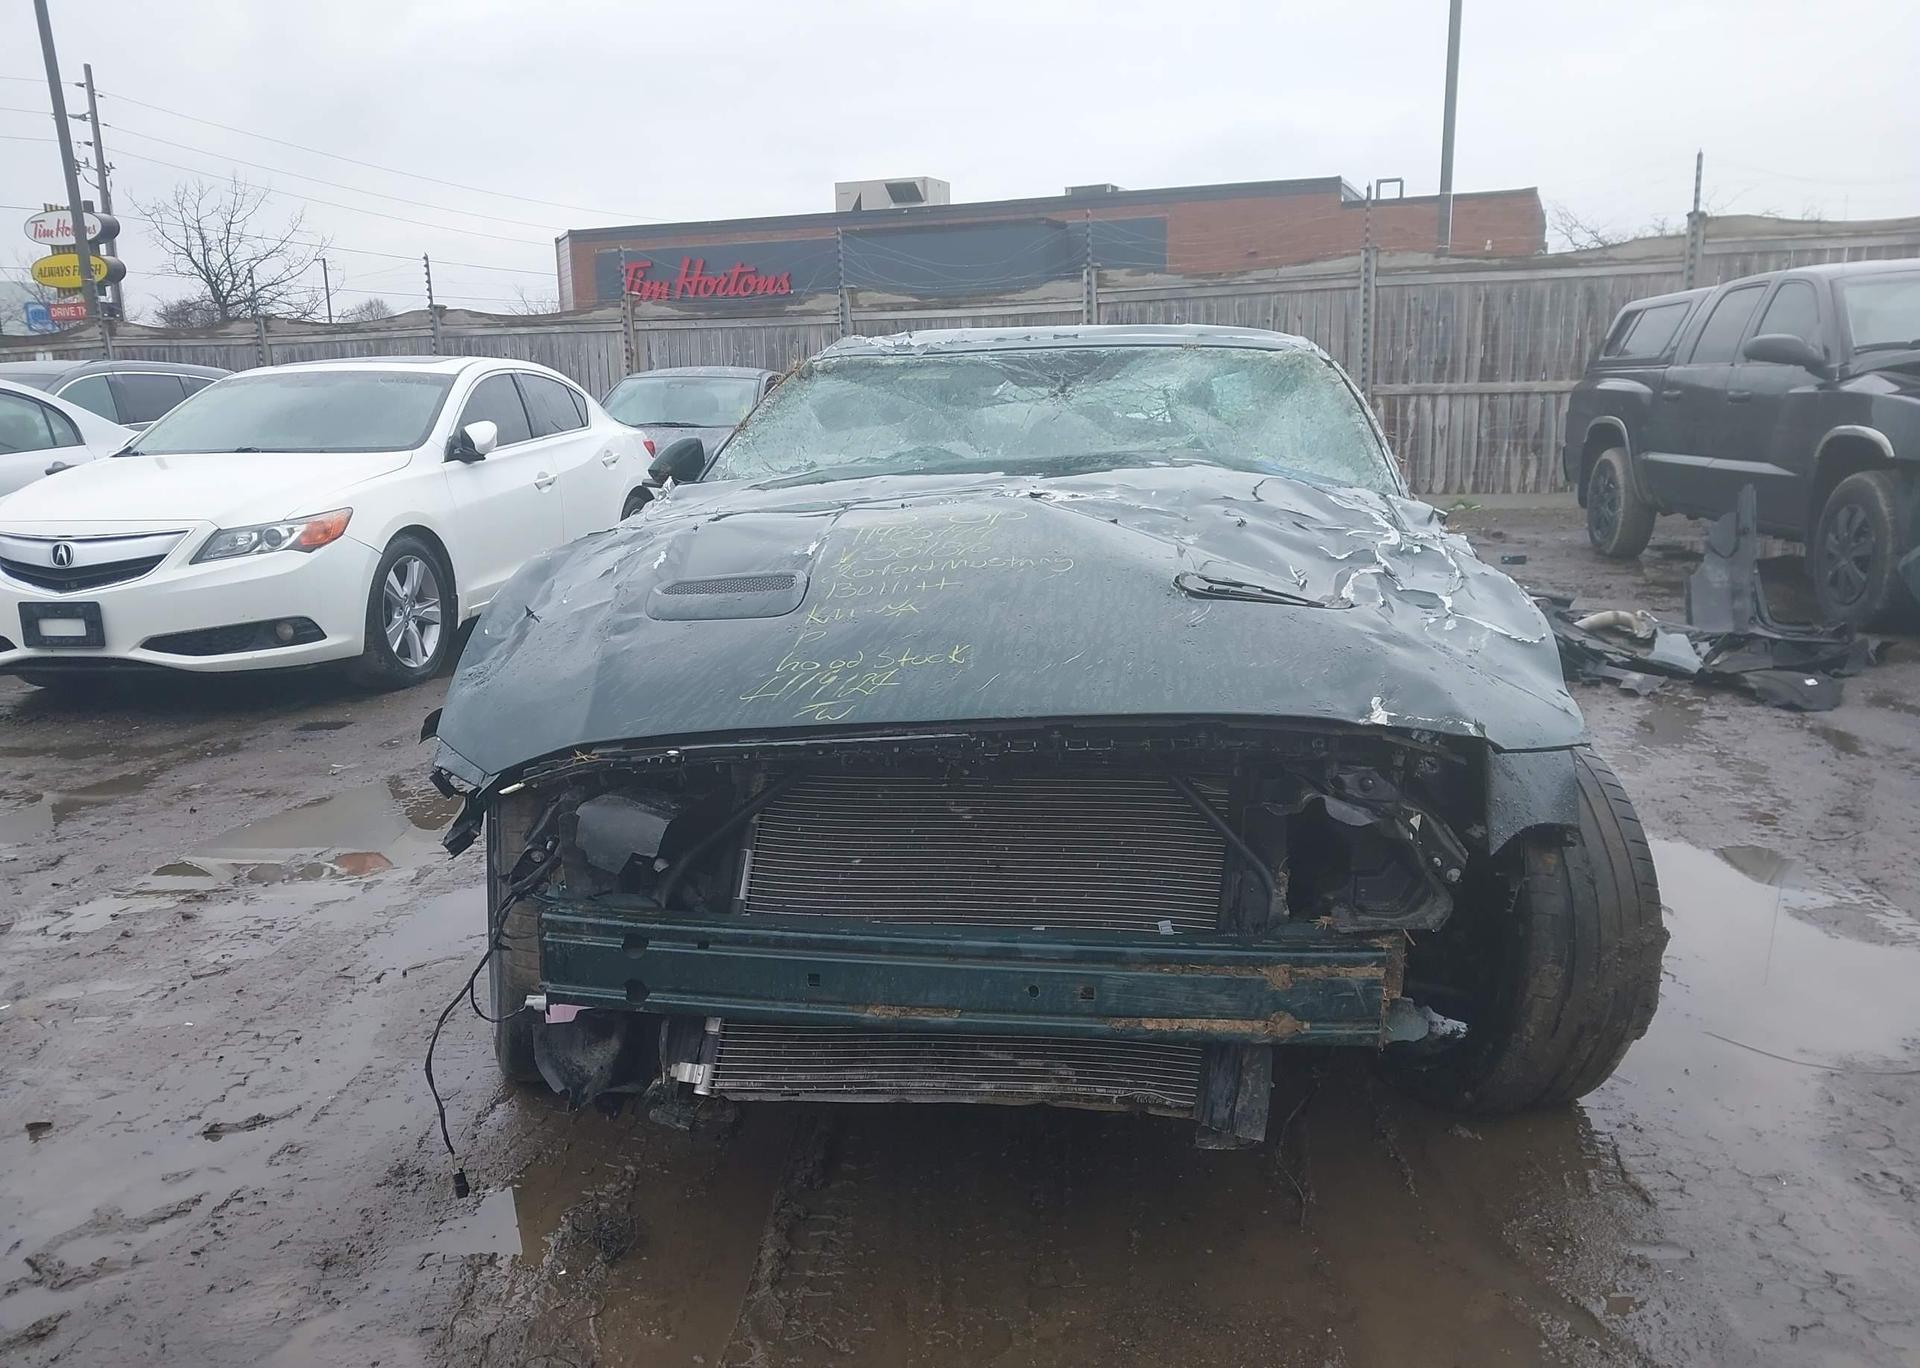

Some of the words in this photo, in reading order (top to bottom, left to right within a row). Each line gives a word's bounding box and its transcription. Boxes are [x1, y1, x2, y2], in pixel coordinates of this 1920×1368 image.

[31, 219, 54, 239] Tim
[55, 218, 97, 239] Hons
[38, 265, 71, 278] ALWAYS
[72, 263, 102, 277] FSH
[624, 259, 670, 301] Tim
[674, 255, 792, 300] Hortons
[50, 305, 76, 318] DRIVE
